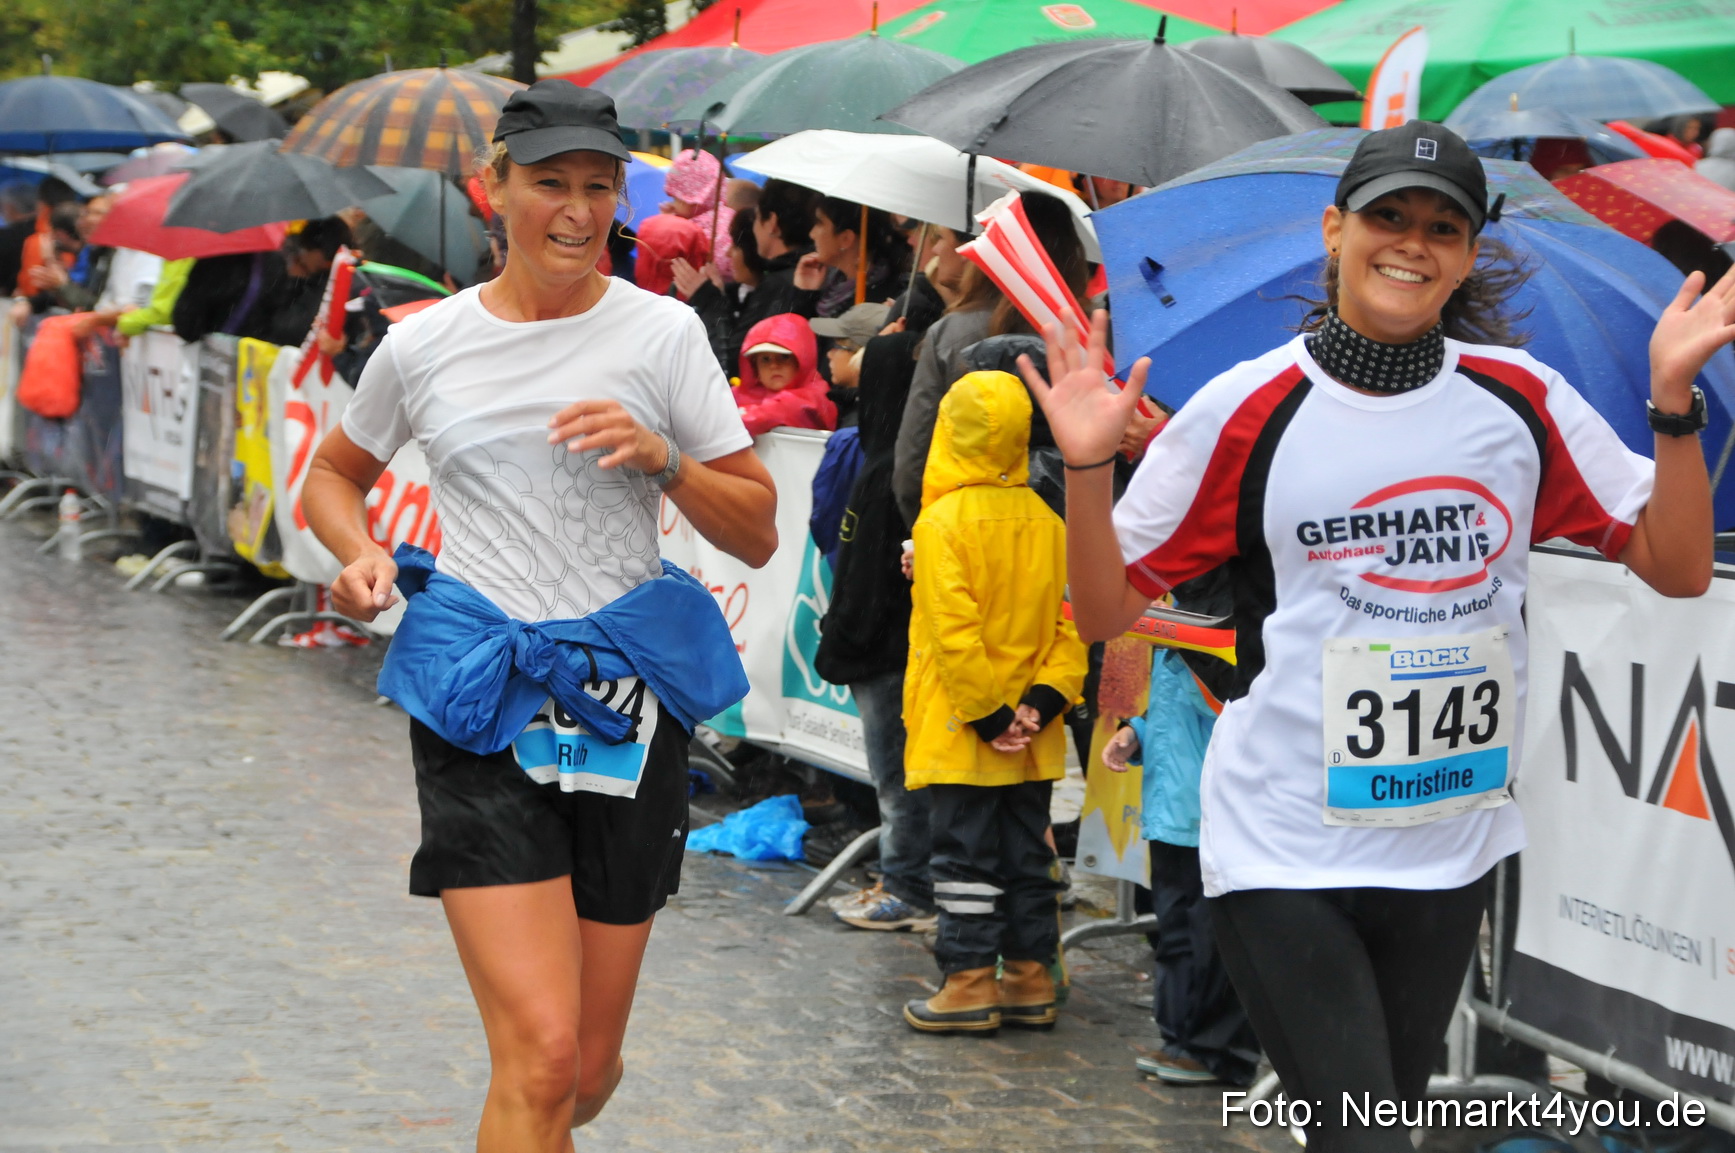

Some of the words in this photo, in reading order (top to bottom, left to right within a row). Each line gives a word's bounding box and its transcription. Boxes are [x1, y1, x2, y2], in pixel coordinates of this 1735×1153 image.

[1296, 503, 1475, 547] GERHART
[1475, 512, 1487, 527] &
[1307, 544, 1386, 562] Autohaus
[1340, 586, 1361, 611] Das
[1363, 600, 1447, 624] sportliche
[1391, 646, 1470, 669] BOCK
[1346, 679, 1500, 759] 3143
[1333, 752, 1341, 763] D
[1371, 768, 1474, 801] Christine
[1664, 1035, 1735, 1087] www.
